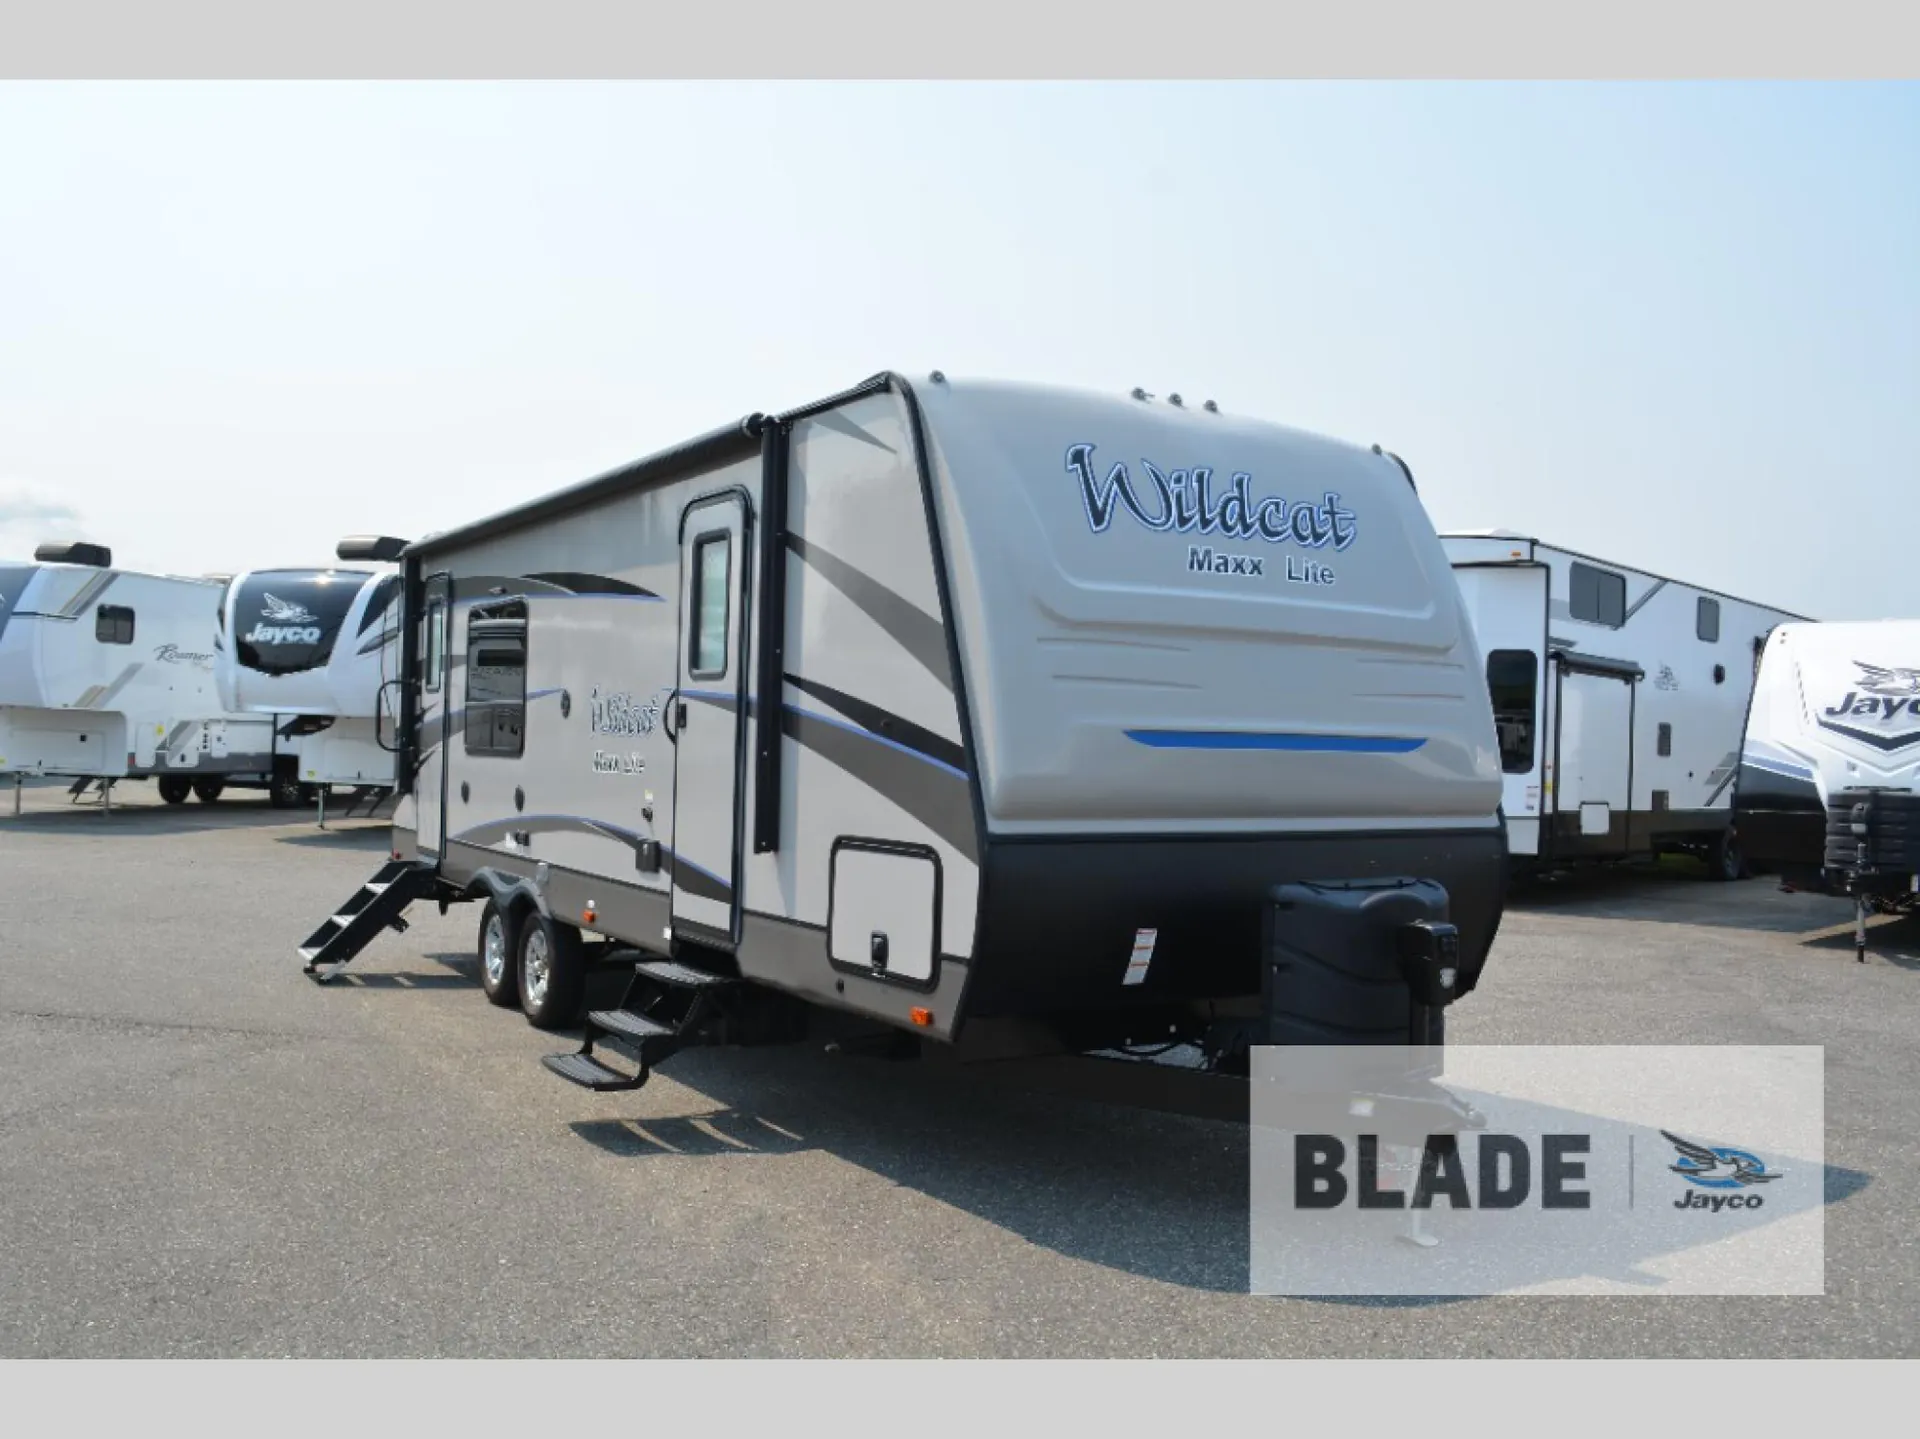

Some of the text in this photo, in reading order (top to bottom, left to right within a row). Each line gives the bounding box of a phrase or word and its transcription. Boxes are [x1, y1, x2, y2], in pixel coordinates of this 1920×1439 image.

[1064, 442, 1358, 553] Wildcat
[1187, 544, 1337, 587] Maxx Lite
[245, 621, 321, 646] Jayco
